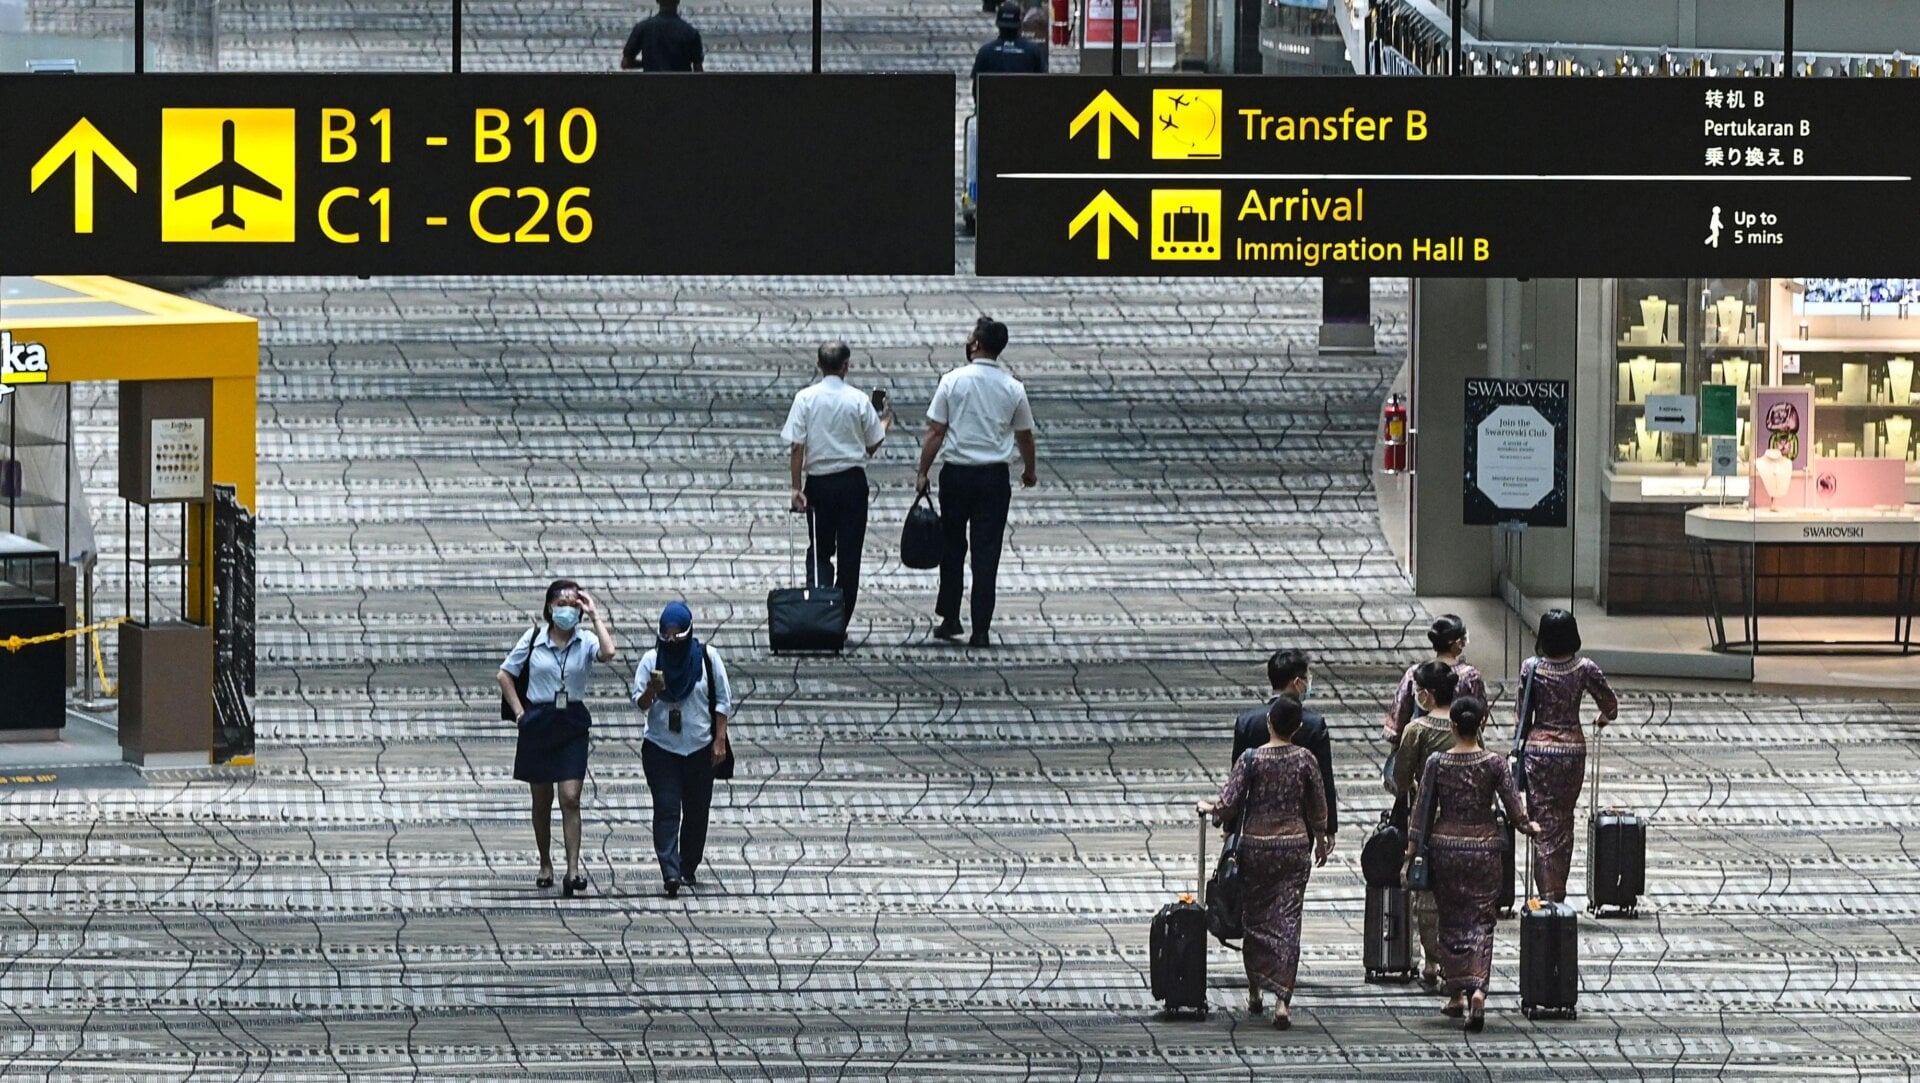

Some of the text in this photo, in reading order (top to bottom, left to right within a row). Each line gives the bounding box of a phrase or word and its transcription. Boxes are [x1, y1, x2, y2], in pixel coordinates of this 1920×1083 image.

[1705, 89, 1765, 109] 转机 B
[1239, 106, 1428, 142] Transfer B
[1704, 119, 1811, 137] Pertukaran B
[320, 107, 391, 164] B1
[474, 107, 598, 164] B10
[1704, 147, 1804, 167] 乗り換え B
[1238, 188, 1363, 222] Arrival
[318, 186, 390, 244] C1
[469, 186, 593, 244] C26
[1734, 211, 1778, 227] Up to
[1734, 230, 1784, 245] 5 mins
[1236, 236, 1490, 267] Immigration Hall B
[1467, 381, 1565, 399] SWAROVSKI
[1499, 418, 1531, 428] Join the
[1484, 428, 1548, 438] Swarovski Club
[1803, 526, 1864, 538] SWAROVSKI
